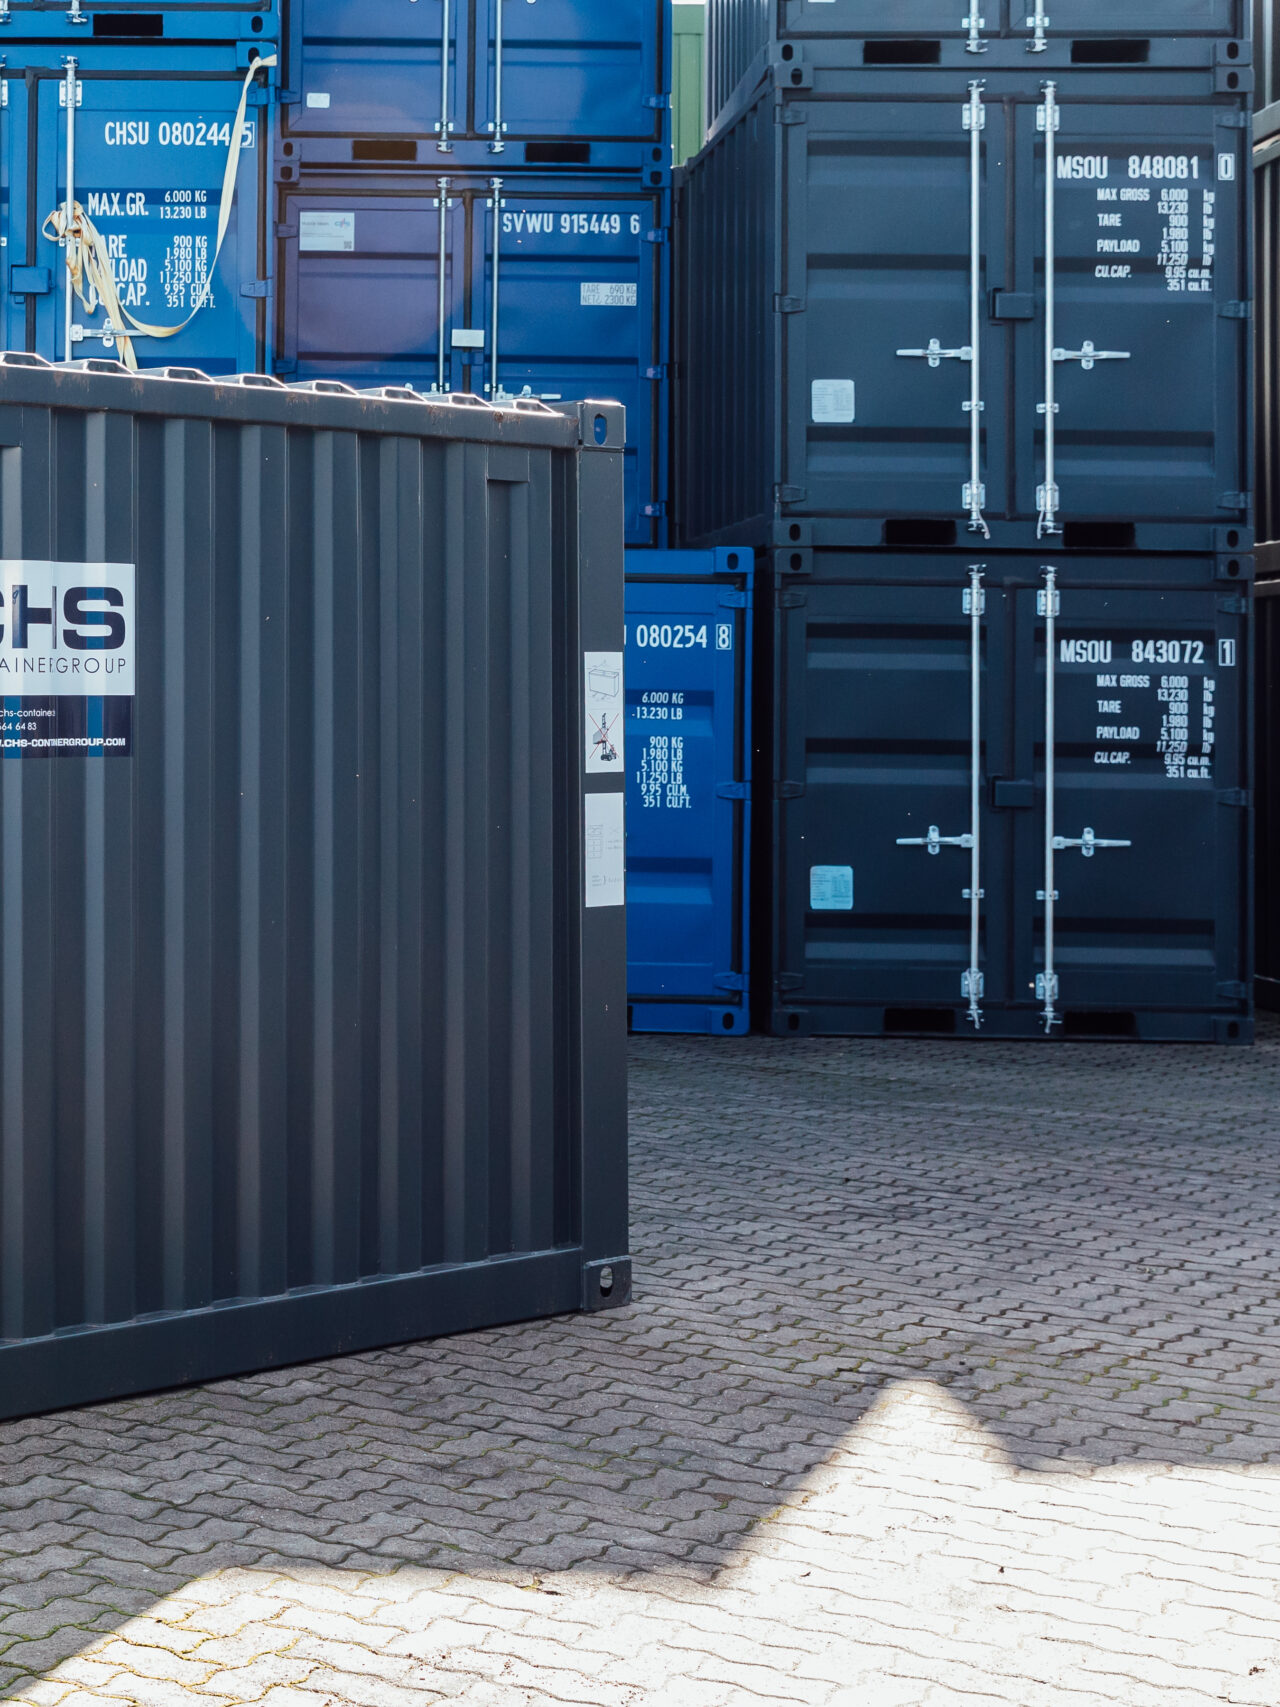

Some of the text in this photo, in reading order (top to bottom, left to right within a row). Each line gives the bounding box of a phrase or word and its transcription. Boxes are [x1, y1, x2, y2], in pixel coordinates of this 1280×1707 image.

[105, 121, 149, 145] CHSU
[158, 122, 230, 146] 080244
[1056, 154, 1233, 179] MSOU 848081 0
[164, 190, 191, 203] 6.000
[195, 190, 206, 203] KG
[1096, 188, 1117, 201] MAX
[1120, 188, 1150, 201] GROSS
[1203, 189, 1215, 203] kg
[160, 206, 206, 219] 13.230 LB
[1203, 202, 1212, 214] lb
[503, 213, 640, 234] SVWU 915449 6
[1097, 213, 1214, 229] TARE 900 kg
[1203, 228, 1212, 240] lb
[173, 235, 192, 247] 900
[195, 235, 207, 248] KG
[1096, 239, 1140, 252] PAYLOAD
[1203, 241, 1214, 255] kg
[166, 247, 207, 260] 1.980 LB
[1202, 253, 1212, 266] lb
[165, 259, 192, 271] 5.100
[195, 260, 207, 271] KG
[160, 271, 207, 283] 11.250 LB
[164, 283, 186, 295] 9.95
[609, 284, 625, 294] 690
[626, 284, 636, 295] KG
[1167, 279, 1185, 291] 351
[167, 295, 184, 308] 351
[626, 295, 636, 305] KG
[636, 624, 707, 648] 080254
[718, 625, 730, 649] 8
[1060, 639, 1112, 663] MSOU
[1132, 639, 1205, 664] 843072
[1097, 674, 1117, 687] MAX
[1120, 675, 1150, 687] GROSS
[1203, 677, 1215, 691] kg
[642, 692, 684, 704] 6.000 KG
[1203, 690, 1213, 702] lb
[636, 707, 683, 720] 13.230 LB
[1097, 700, 1215, 717] TARE 900 kg
[15, 722, 26, 731] 64
[27, 722, 37, 731] 83
[1203, 716, 1212, 728] lb
[1096, 726, 1140, 739] PAYLOAD
[1203, 729, 1214, 743] kg
[650, 736, 683, 749] 900 KG
[1202, 742, 1211, 754] lb
[642, 748, 683, 760] 1.980 LB
[641, 760, 683, 772] 5.100 KG
[1166, 766, 1185, 778] 351
[636, 772, 682, 784] 11.250 LB
[641, 784, 661, 796] 9.95
[643, 796, 660, 808] 351
